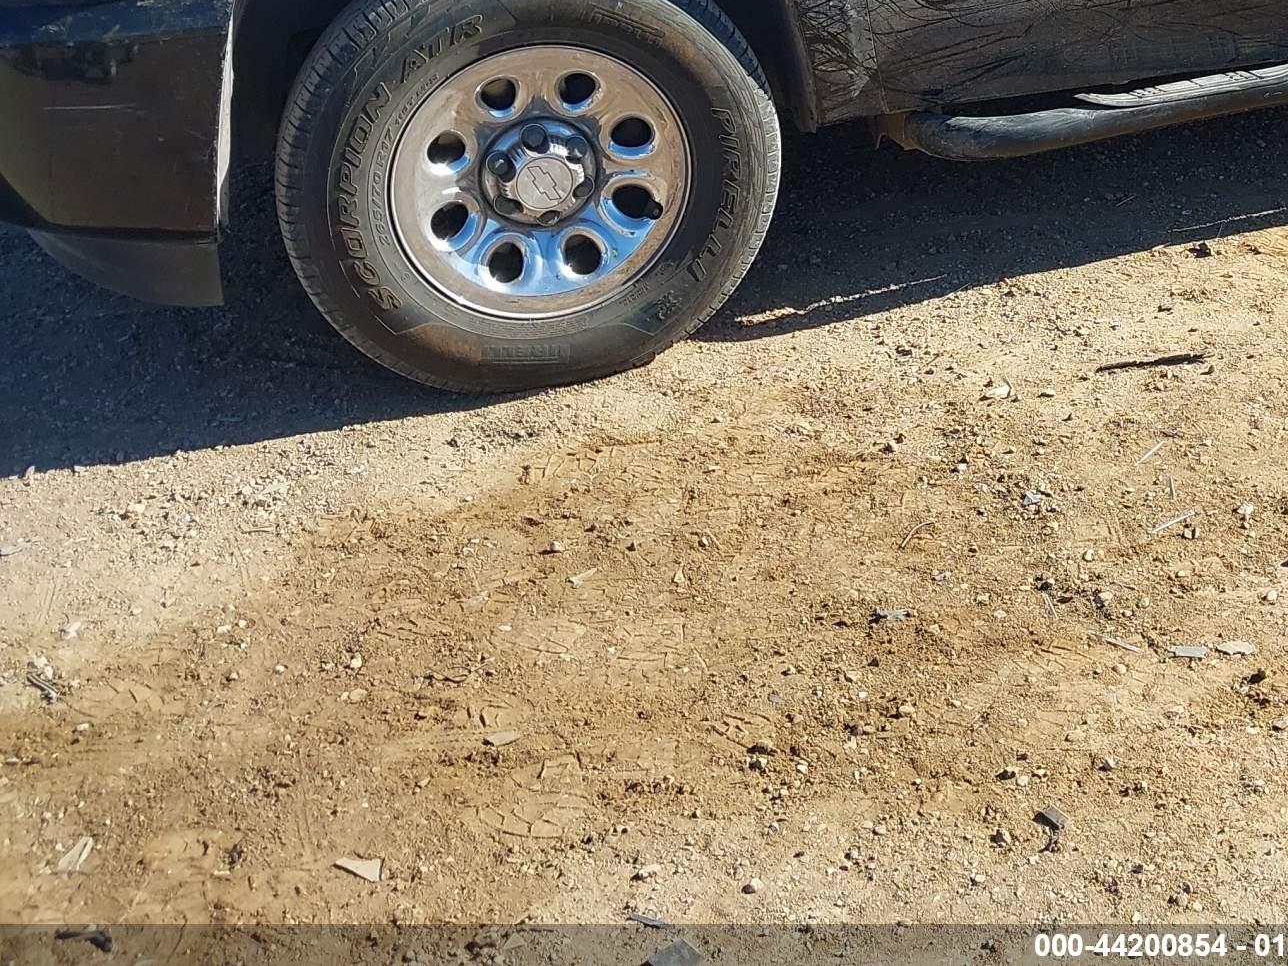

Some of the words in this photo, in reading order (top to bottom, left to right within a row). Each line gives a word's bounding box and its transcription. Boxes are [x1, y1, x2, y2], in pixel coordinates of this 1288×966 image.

[337, 81, 402, 311] SCORPION
[400, 14, 483, 84] ATR
[686, 106, 742, 282] PIRELLI
